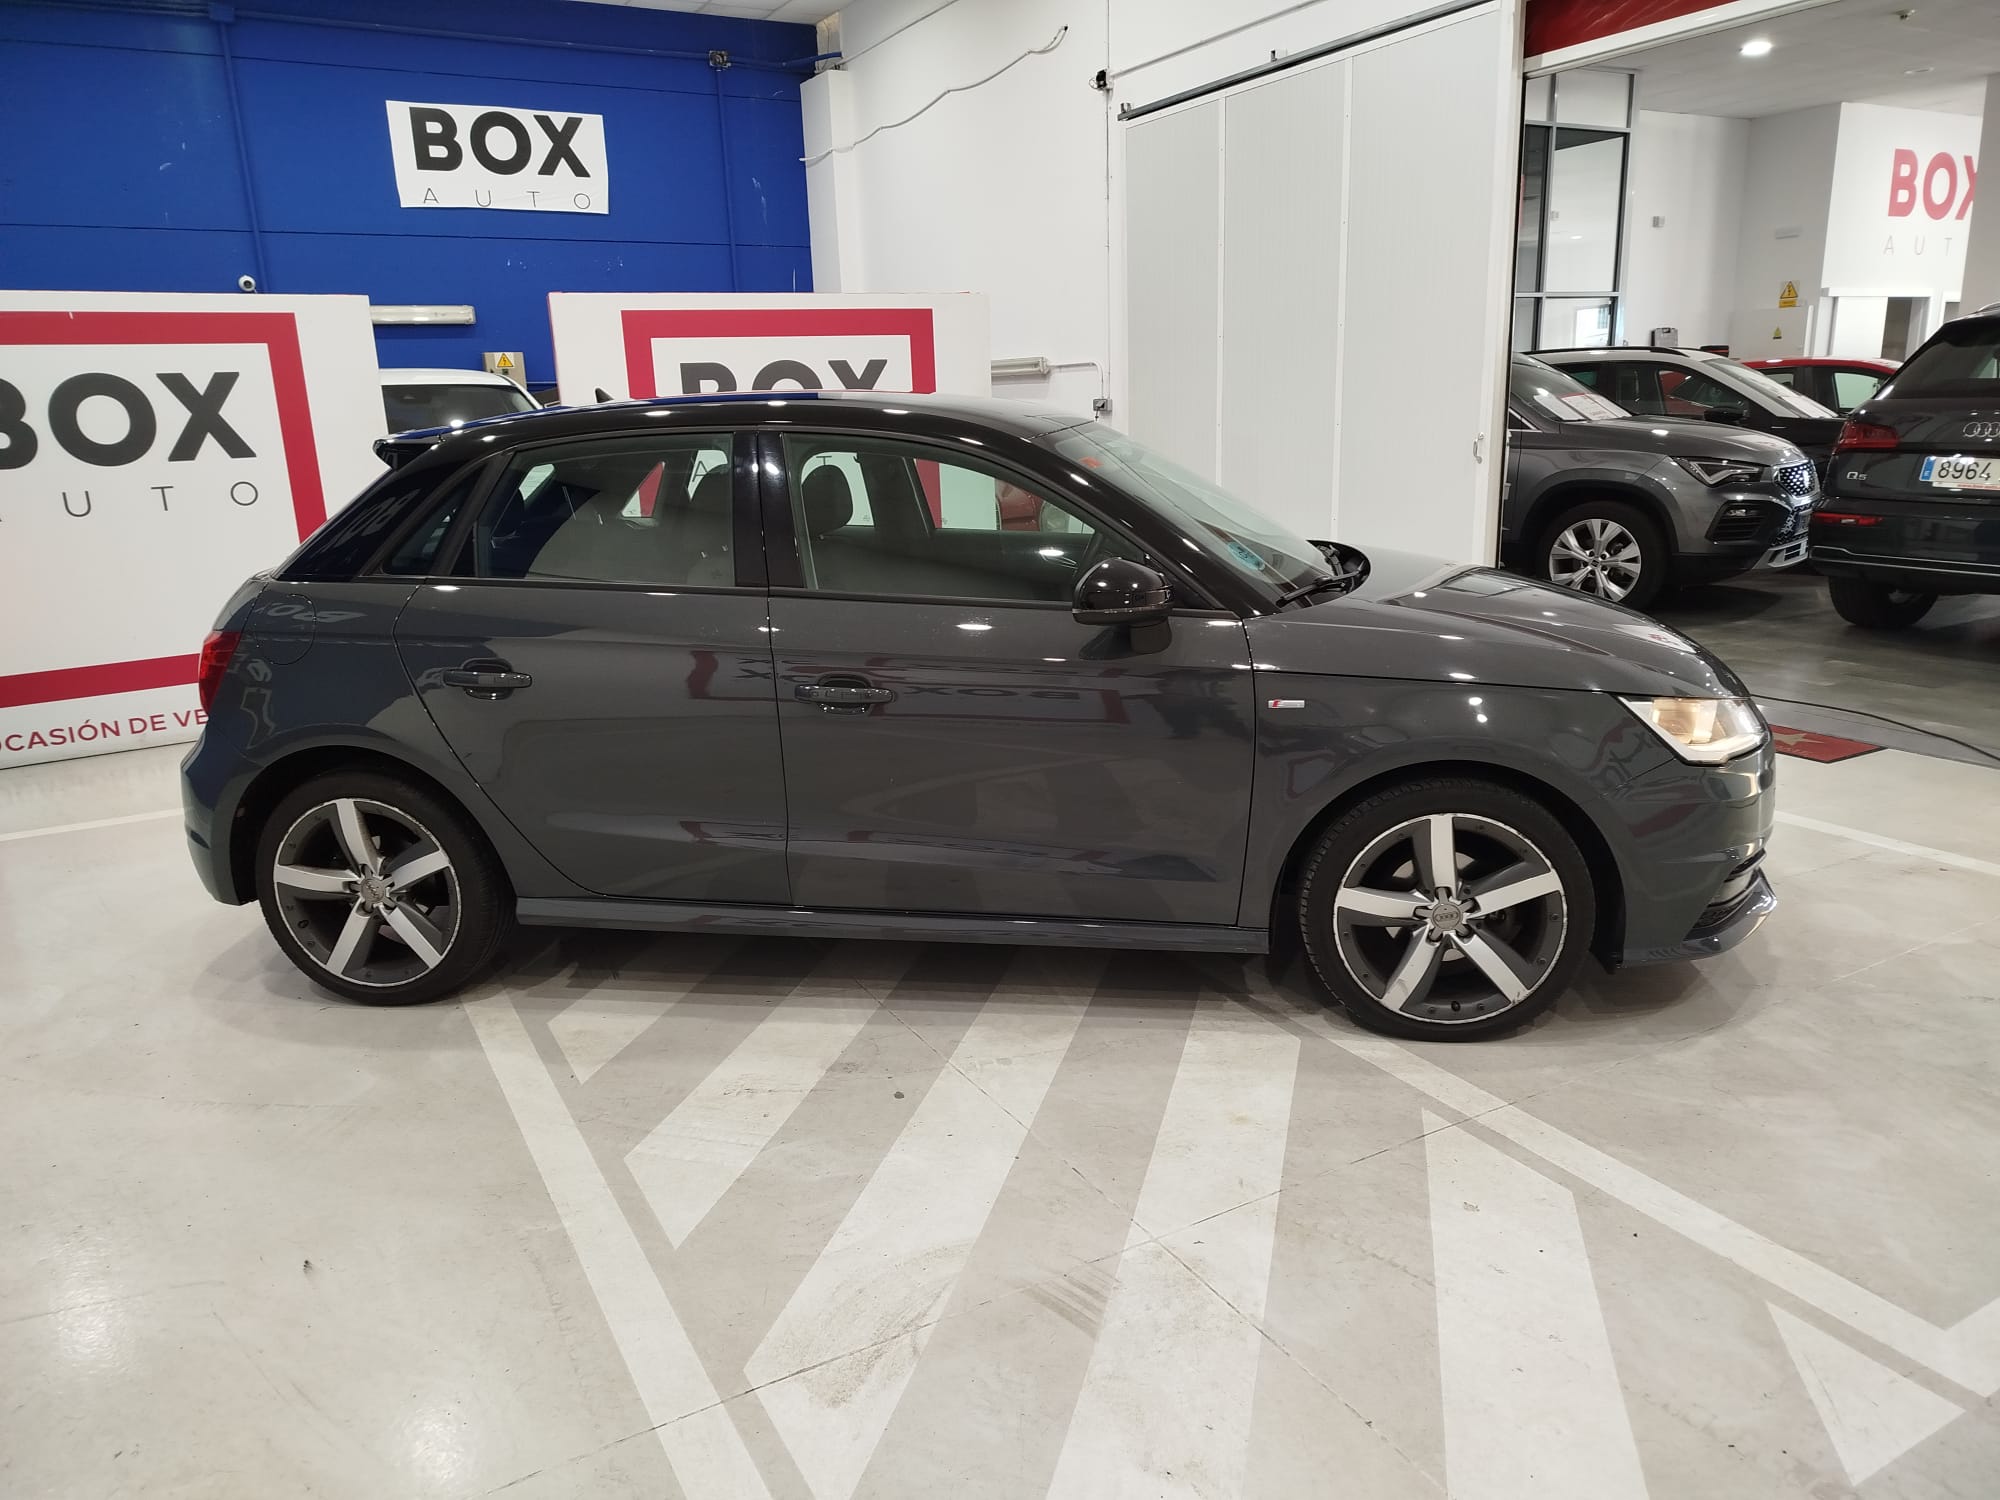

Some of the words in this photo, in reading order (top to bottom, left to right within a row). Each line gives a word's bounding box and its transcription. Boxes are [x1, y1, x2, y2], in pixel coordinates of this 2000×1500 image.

[409, 107, 591, 178] BOX
[423, 188, 591, 209] AUTO
[1883, 235, 1953, 256] AUT
[1846, 471, 1868, 481] Q5
[1938, 460, 1992, 481] 8964
[0, 482, 258, 522] UTO
[0, 719, 121, 751] CASIÓN
[129, 714, 167, 735] DE
